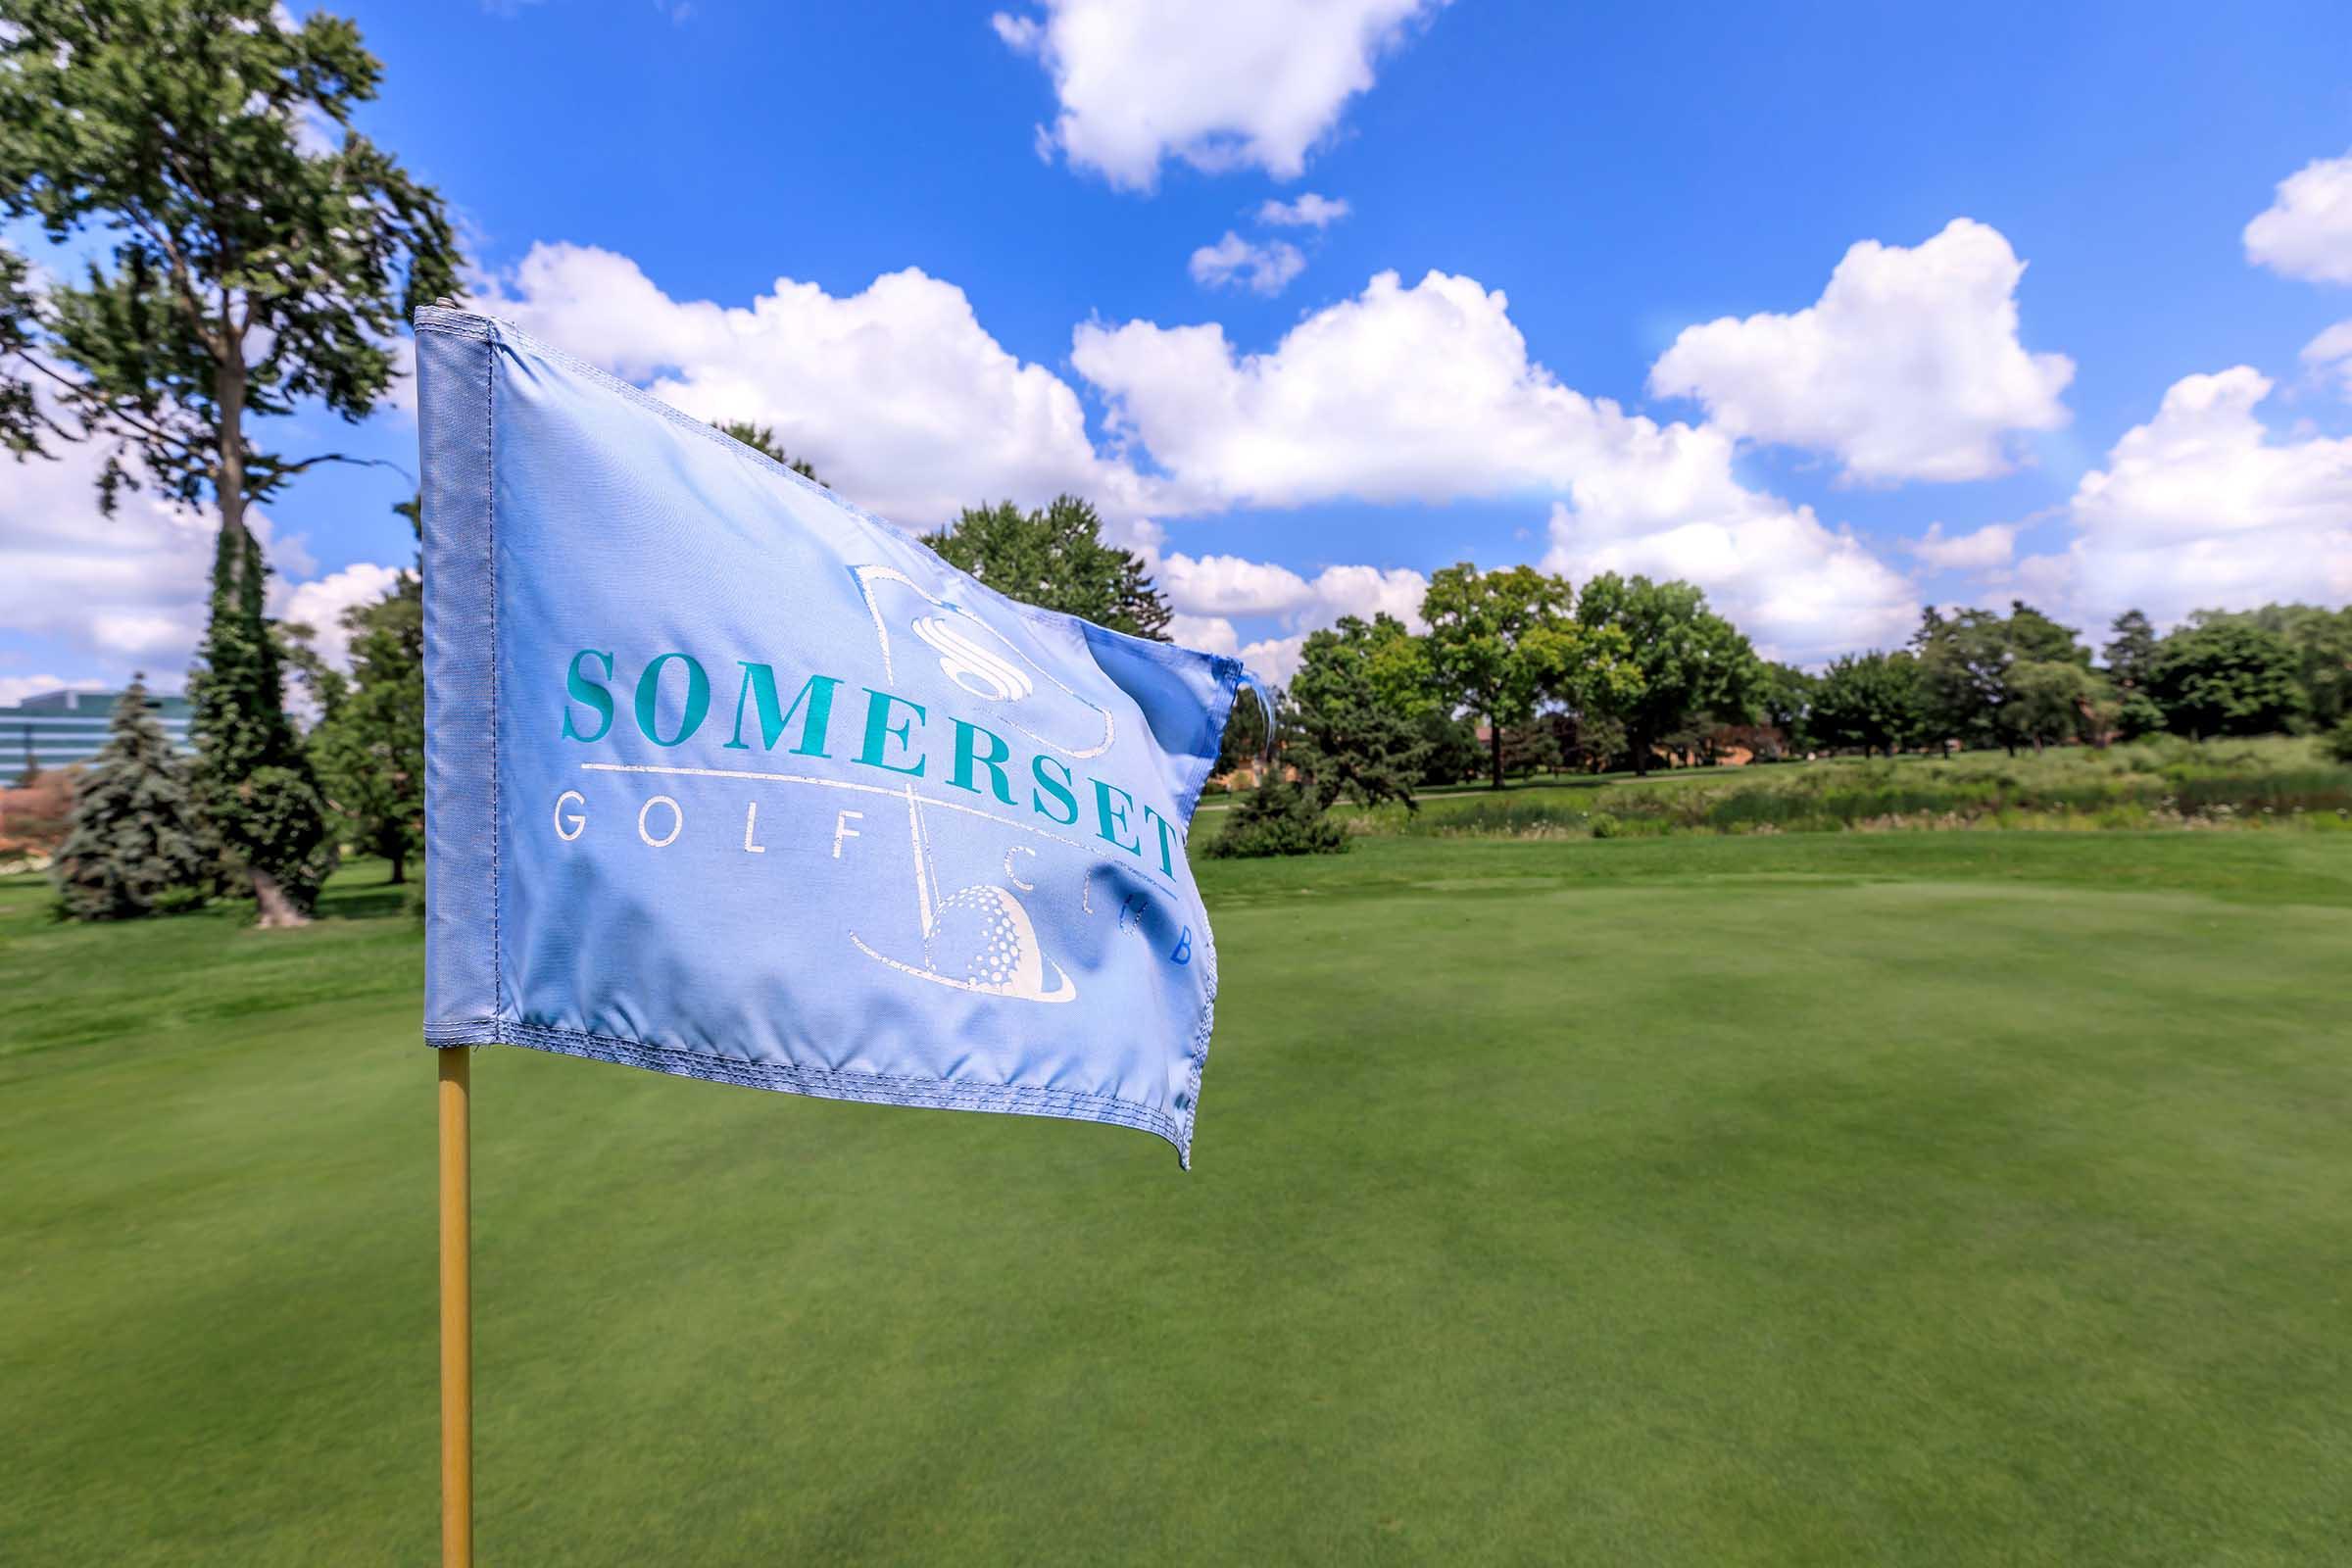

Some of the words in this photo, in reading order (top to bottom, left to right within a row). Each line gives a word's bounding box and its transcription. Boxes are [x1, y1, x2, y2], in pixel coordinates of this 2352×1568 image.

[561, 649, 1177, 882] SOMERSET
[554, 790, 863, 858] GOLF
[1004, 846, 1192, 965] CLUB
